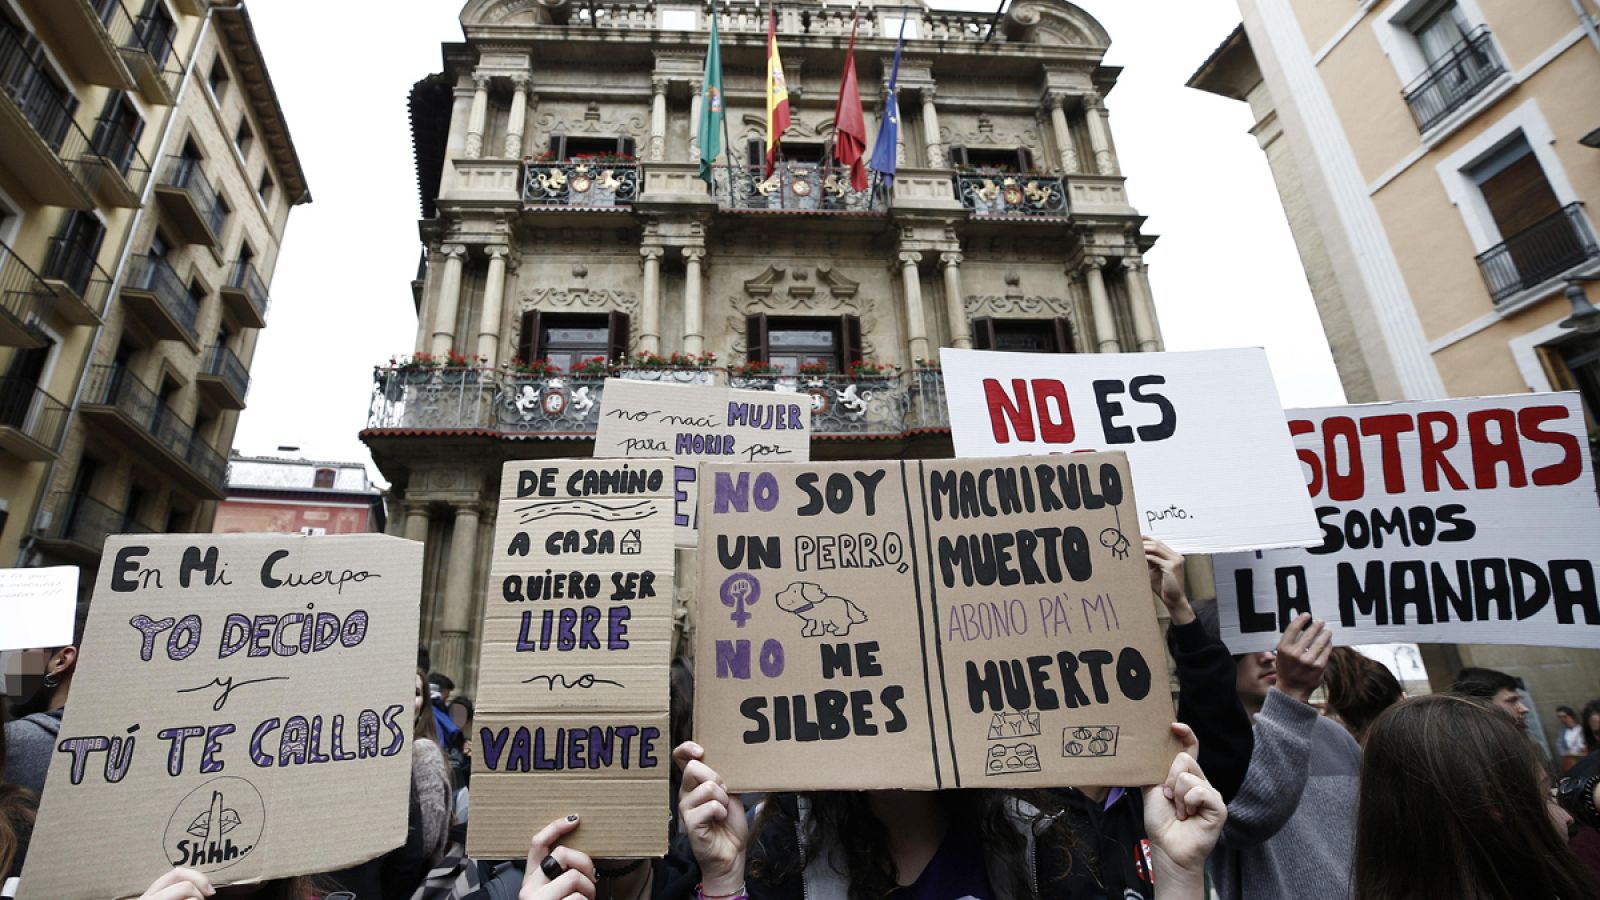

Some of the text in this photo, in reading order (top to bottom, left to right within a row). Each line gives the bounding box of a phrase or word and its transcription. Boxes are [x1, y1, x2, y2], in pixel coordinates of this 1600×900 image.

[605, 408, 662, 421] no
[727, 401, 804, 430] MUJER
[982, 375, 1177, 444] NO ES
[616, 433, 793, 462] para MORIR por
[517, 464, 663, 498] DE CAMINO
[713, 471, 780, 514] NO
[795, 469, 886, 516] SOY
[930, 463, 1123, 521] MACHIRULO
[507, 529, 615, 556] A CASA
[1146, 506, 1194, 531] punto.
[1305, 504, 1477, 555] SOMOS
[110, 546, 382, 595] En Mi Cuerpo
[717, 534, 781, 569] UN
[938, 526, 1093, 588] MUERTO
[502, 569, 656, 602] QUIERO SER
[1235, 558, 1600, 634] LA MANADA
[129, 602, 369, 662] YO DECIDO
[516, 605, 631, 652] LIBRE
[949, 599, 1028, 642] ABONO
[1081, 593, 1120, 633] MI
[521, 674, 625, 691] no
[715, 638, 883, 680] NO ME
[965, 647, 1152, 713] HUERTO
[740, 685, 907, 744] SILBES
[58, 704, 404, 785] TÚ TE CALLAS
[480, 725, 660, 773] VALIENTE
